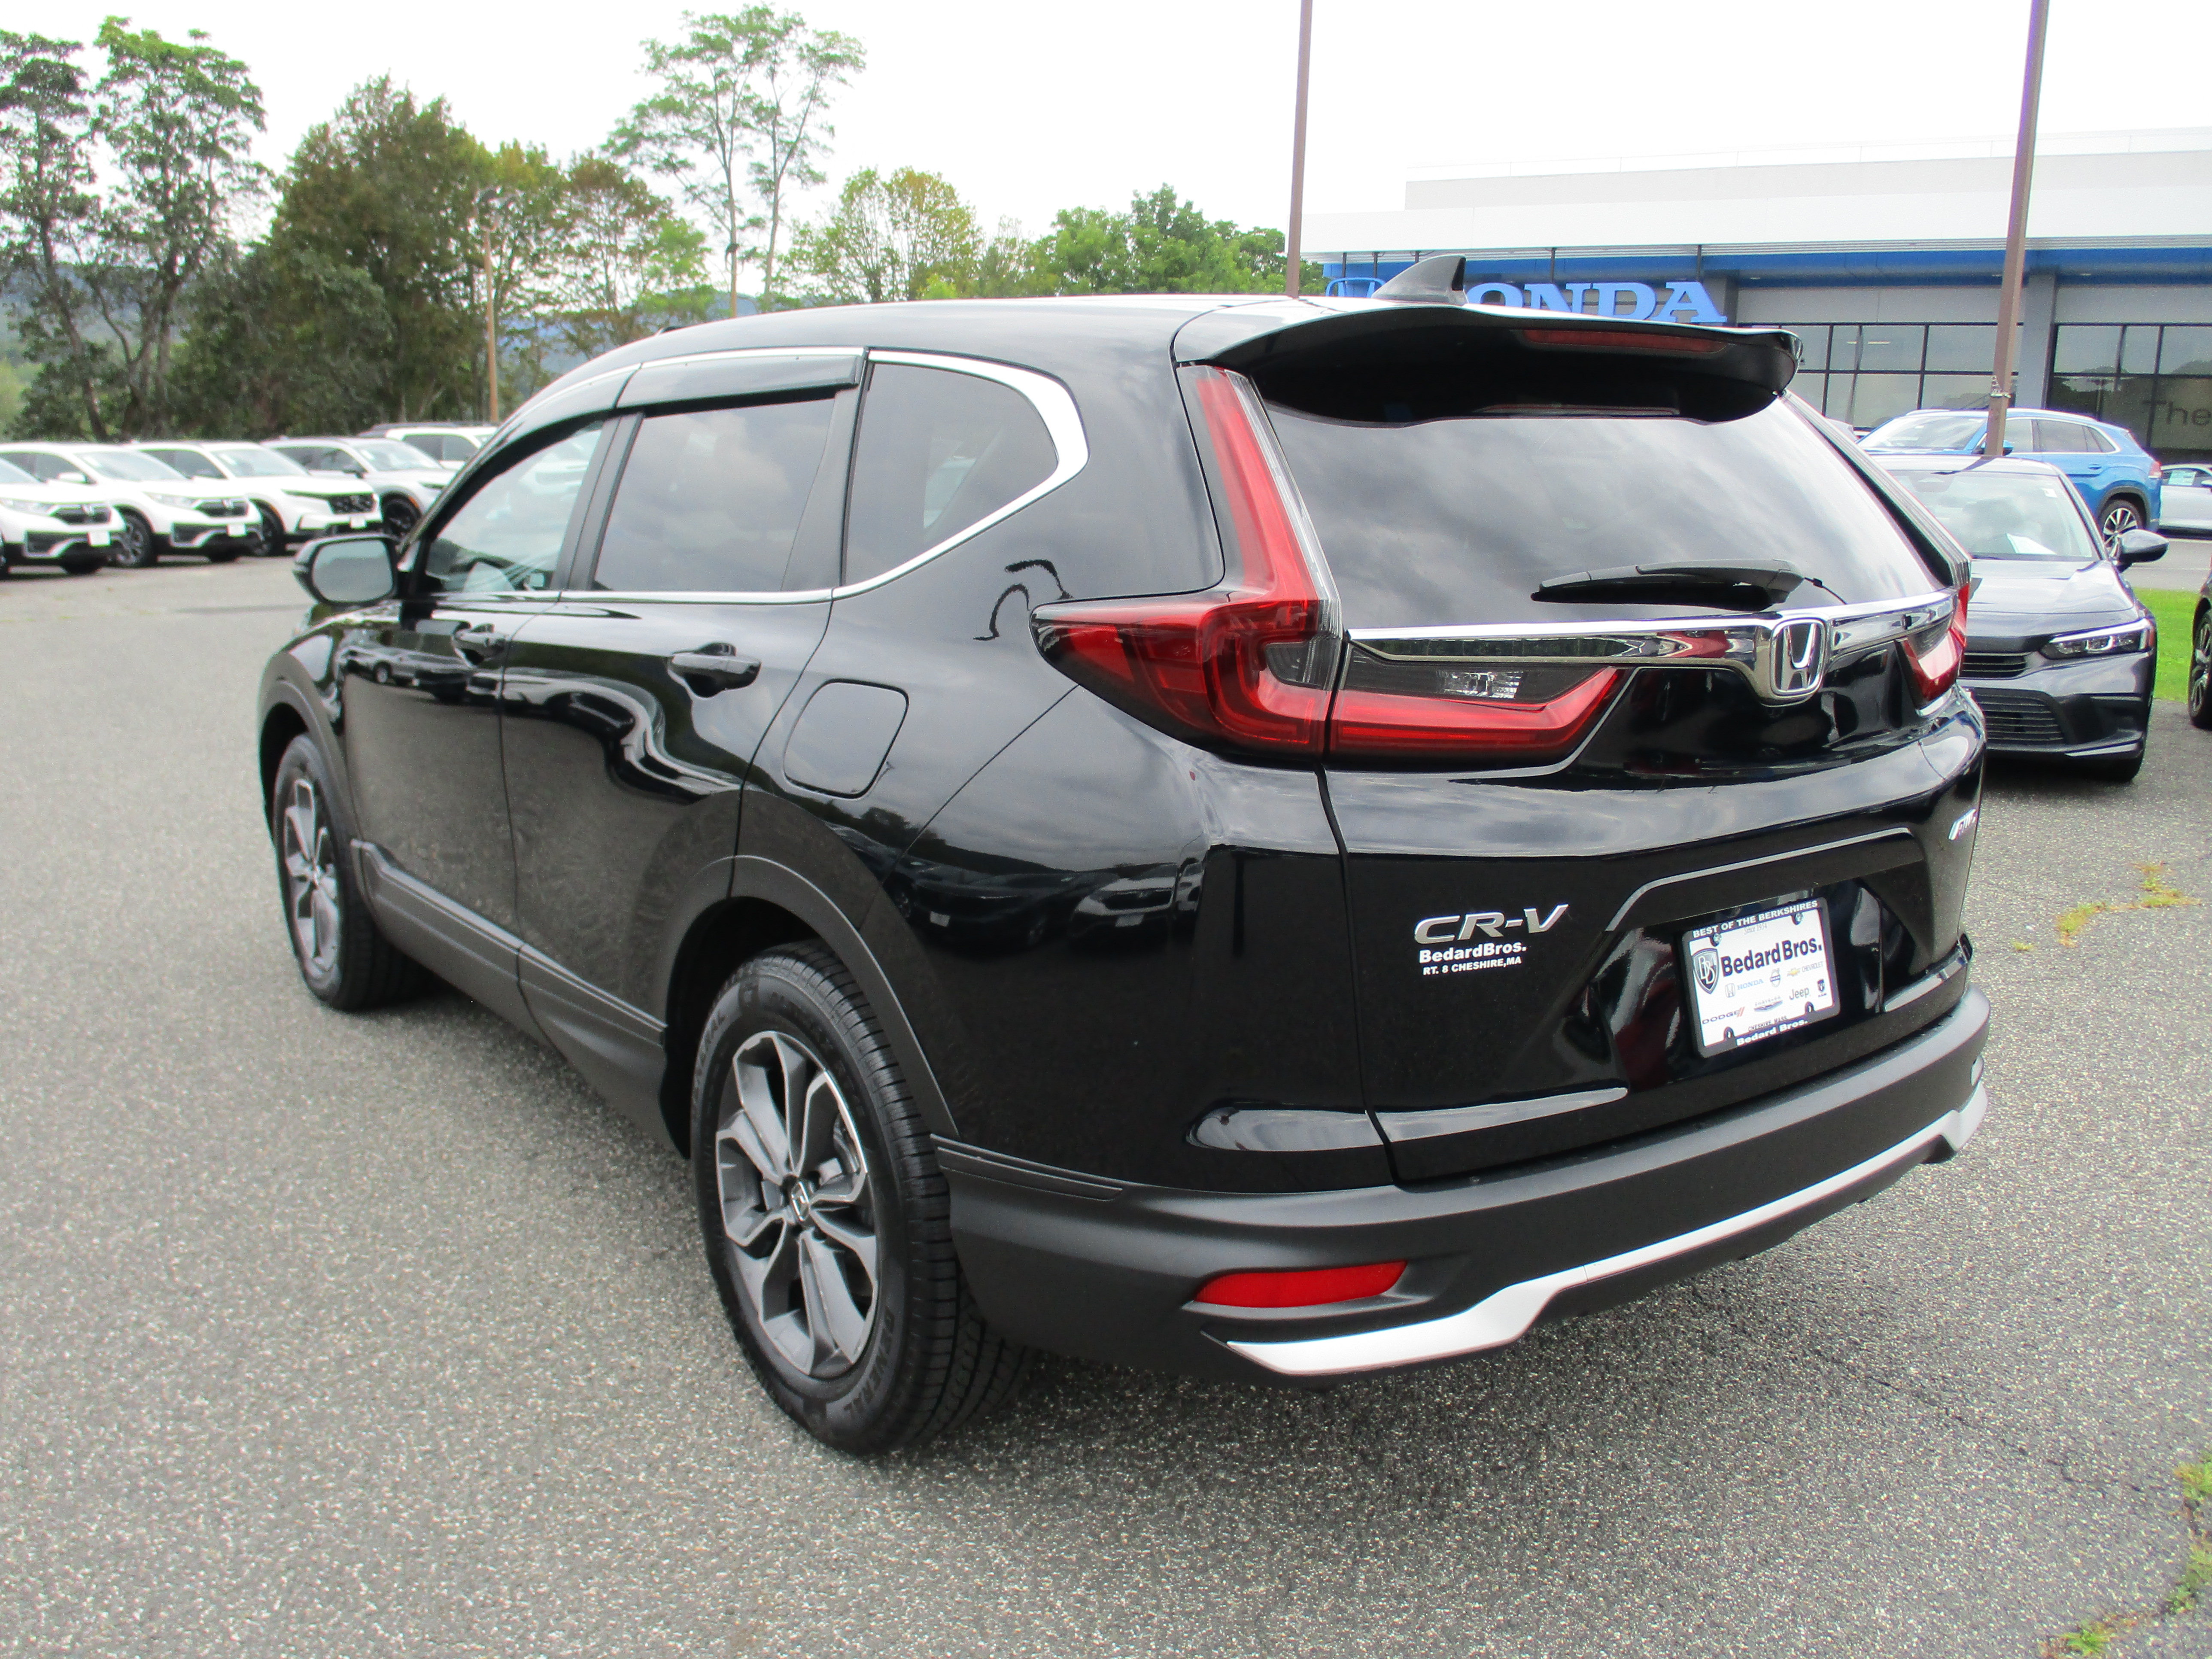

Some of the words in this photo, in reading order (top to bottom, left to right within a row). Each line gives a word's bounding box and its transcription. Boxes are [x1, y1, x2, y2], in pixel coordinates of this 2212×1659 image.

[1465, 281, 1727, 323] ONDA
[1414, 904, 1569, 944] CR-V
[1693, 925, 1719, 939] BEST
[1721, 921, 1735, 930] OF
[1736, 915, 1757, 927] THE
[1758, 900, 1819, 921] BERKSHIRES
[1423, 966, 1439, 975] RT.
[1442, 964, 1449, 973] 8
[1802, 961, 1823, 972] CHEVROLET
[1737, 979, 1764, 990] HONDA
[1789, 988, 1810, 1000] Jeep
[1736, 1027, 1777, 1046] Bedard
